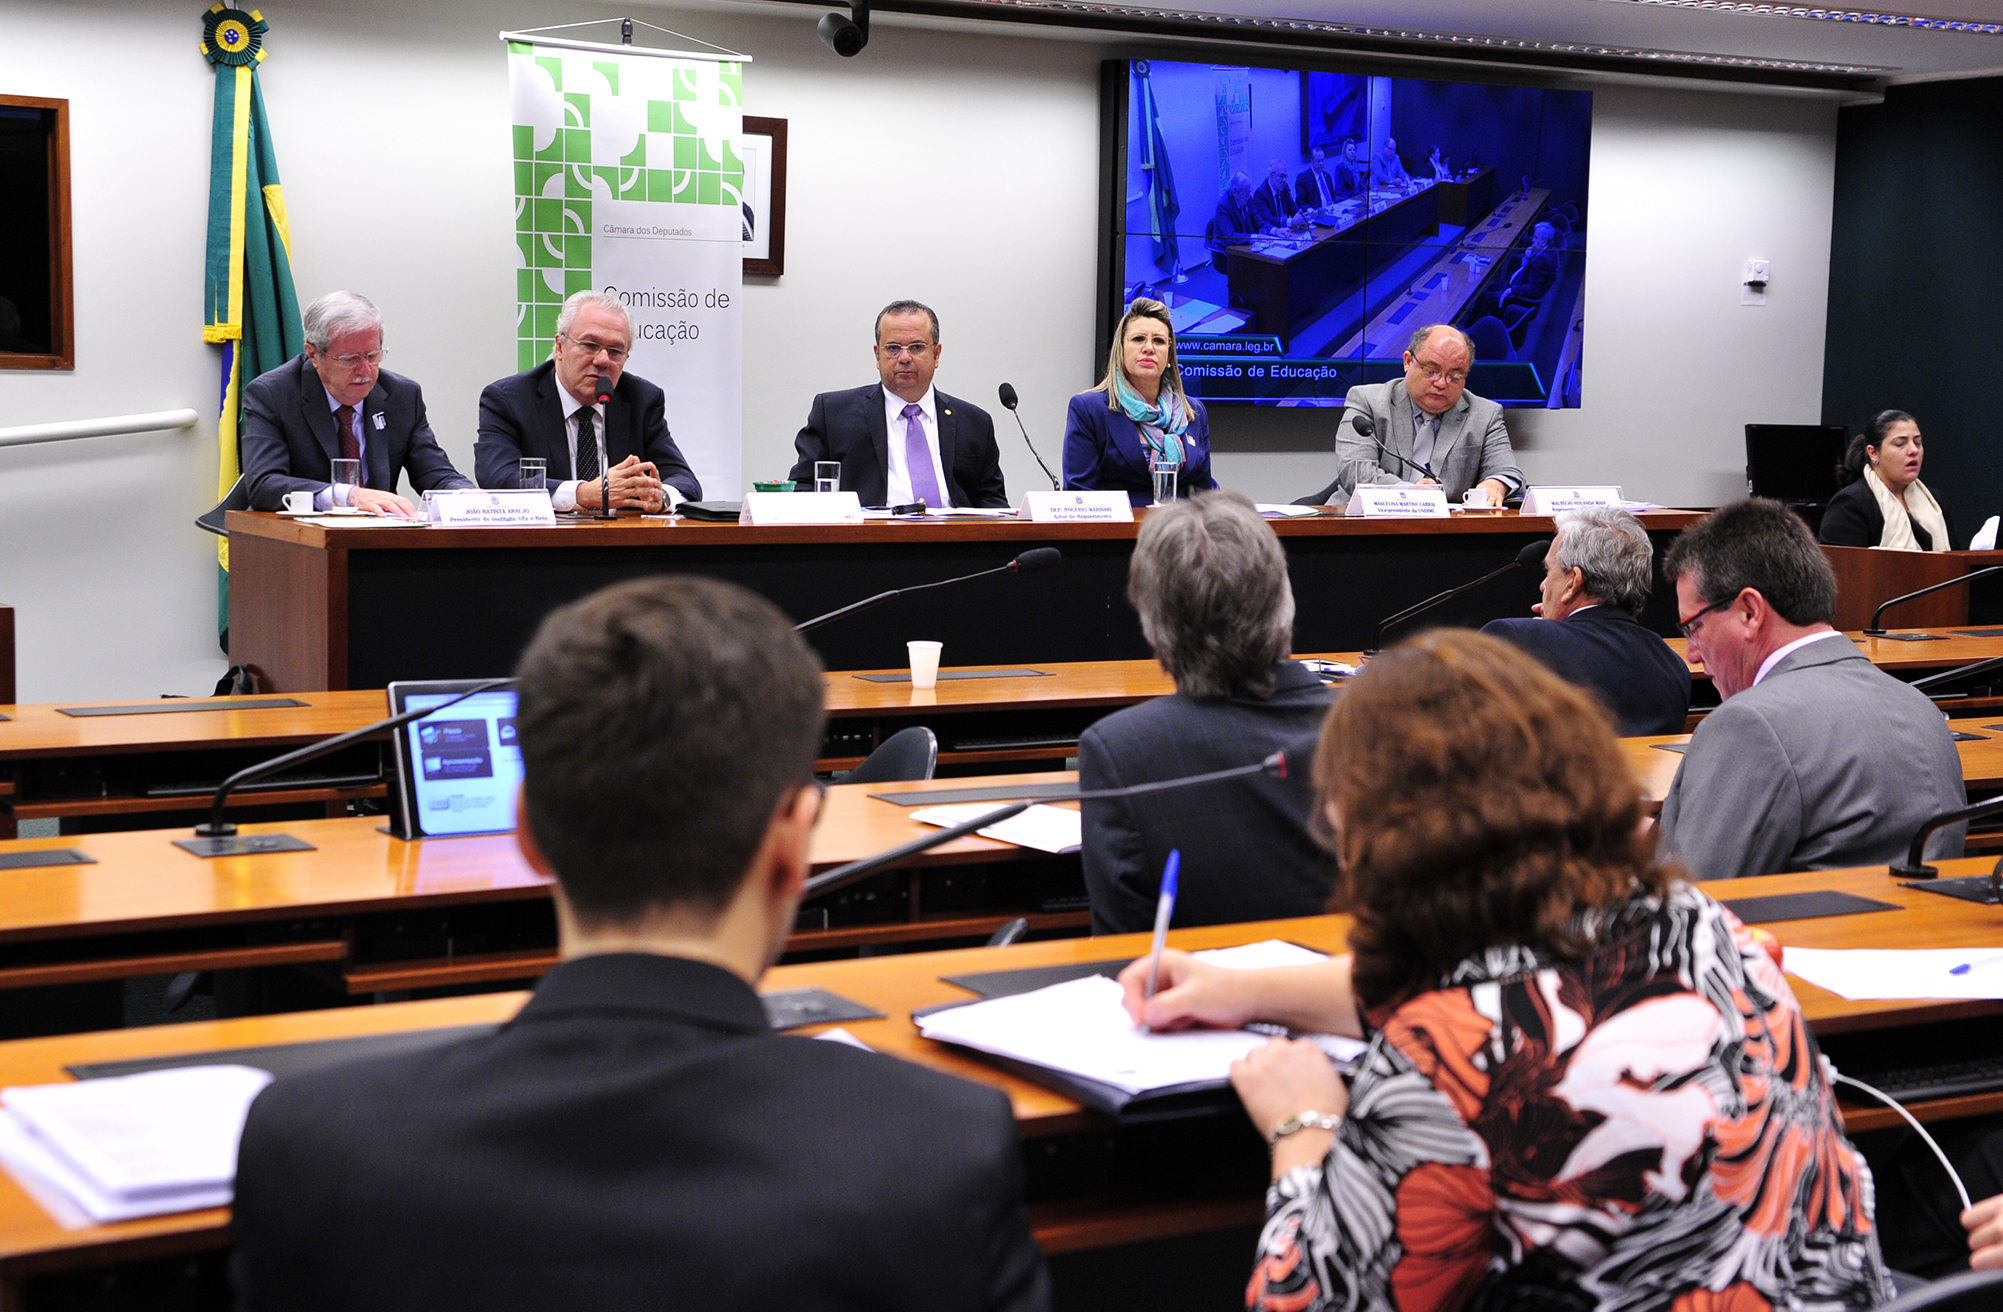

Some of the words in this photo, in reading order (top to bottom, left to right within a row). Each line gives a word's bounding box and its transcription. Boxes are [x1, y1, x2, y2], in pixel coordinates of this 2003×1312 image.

[603, 224, 635, 234] Câmara
[636, 225, 651, 235] dos
[652, 226, 692, 237] Deputados
[704, 288, 730, 309] de
[1176, 341, 1274, 354] www.camara.leg.br
[1247, 365, 1265, 377] de
[1270, 365, 1337, 381] Educação
[465, 507, 481, 515] JOÃO
